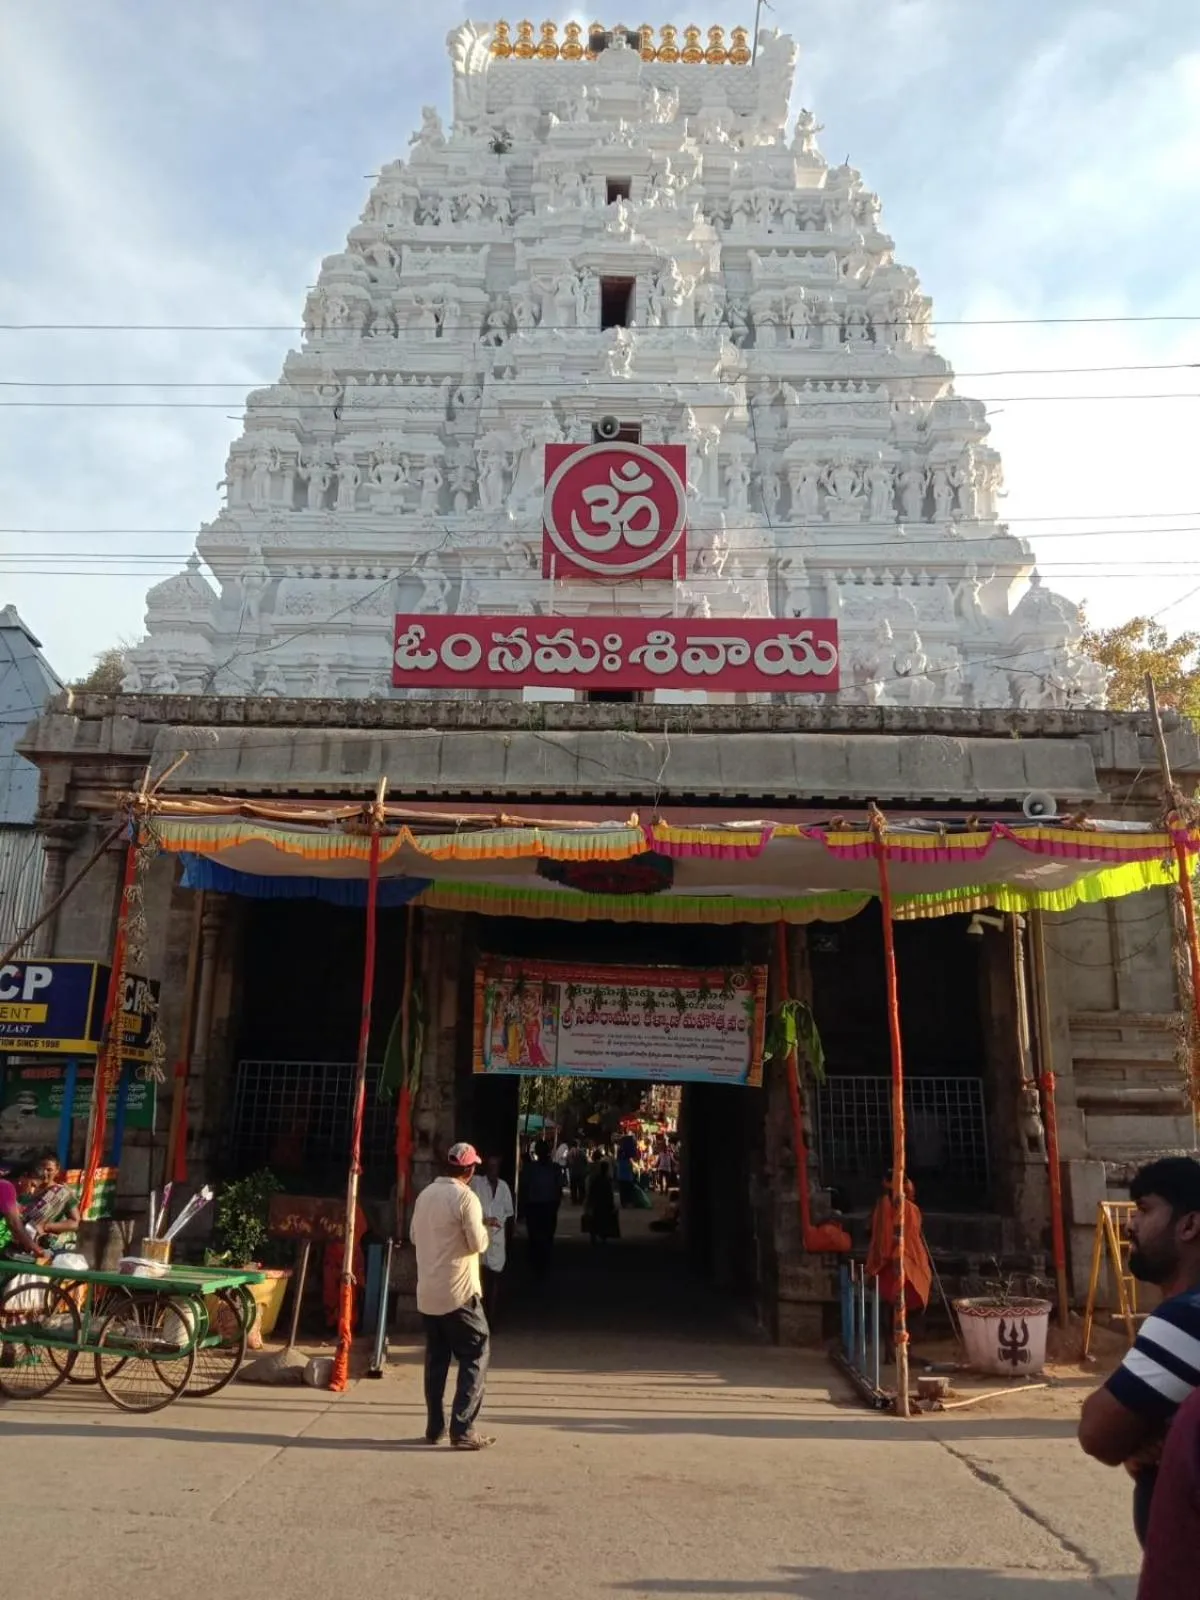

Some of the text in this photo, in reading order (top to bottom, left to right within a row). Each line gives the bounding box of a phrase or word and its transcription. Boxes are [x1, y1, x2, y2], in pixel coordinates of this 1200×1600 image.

[394, 623, 838, 677] ఓం నమః శివాయ
